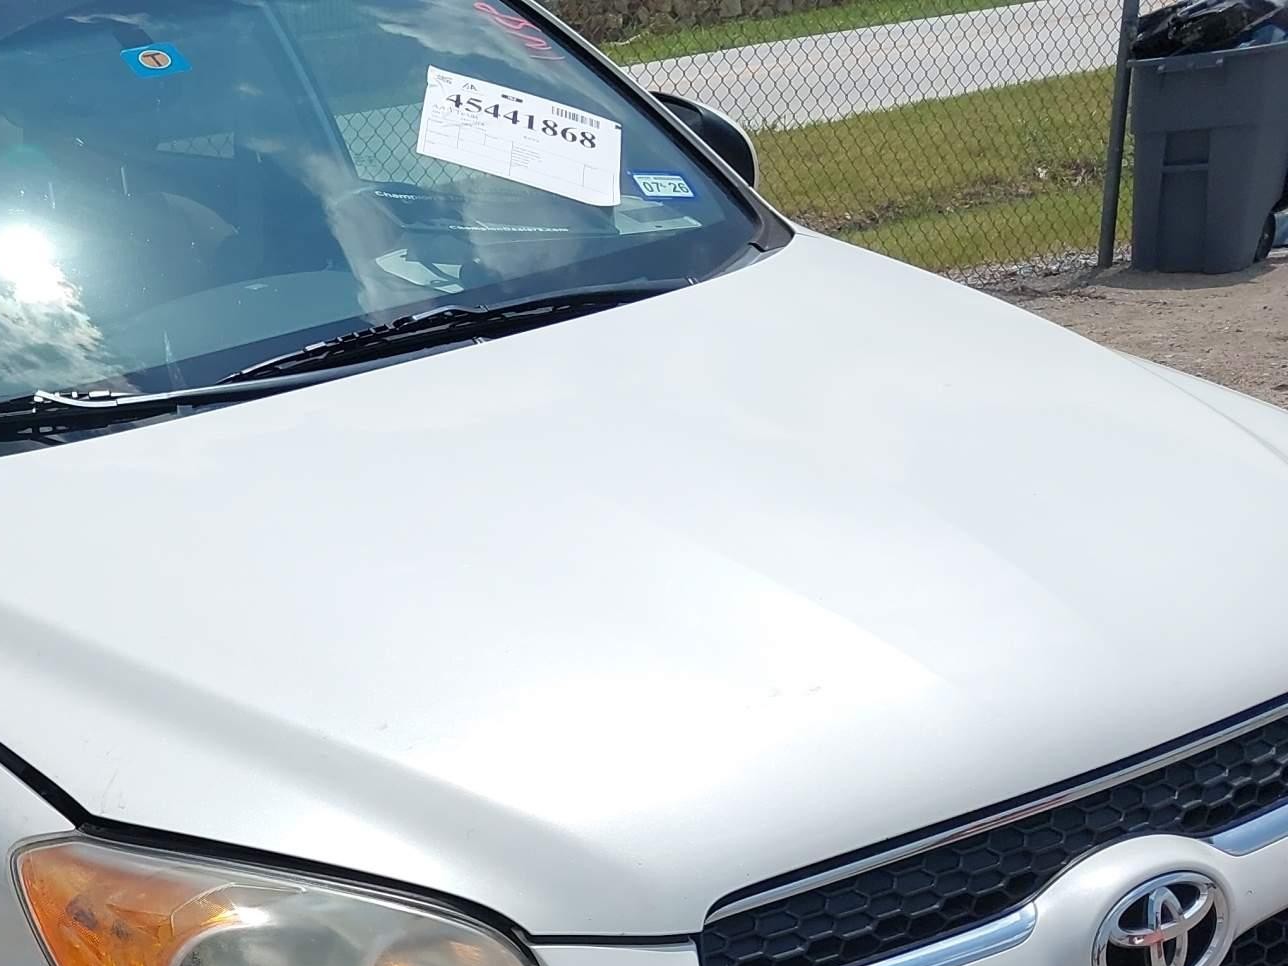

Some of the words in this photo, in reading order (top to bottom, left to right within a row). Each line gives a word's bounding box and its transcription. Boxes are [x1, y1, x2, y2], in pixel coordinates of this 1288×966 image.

[445, 94, 597, 149] 45441868
[642, 181, 661, 193] 07
[668, 182, 689, 193] 26
